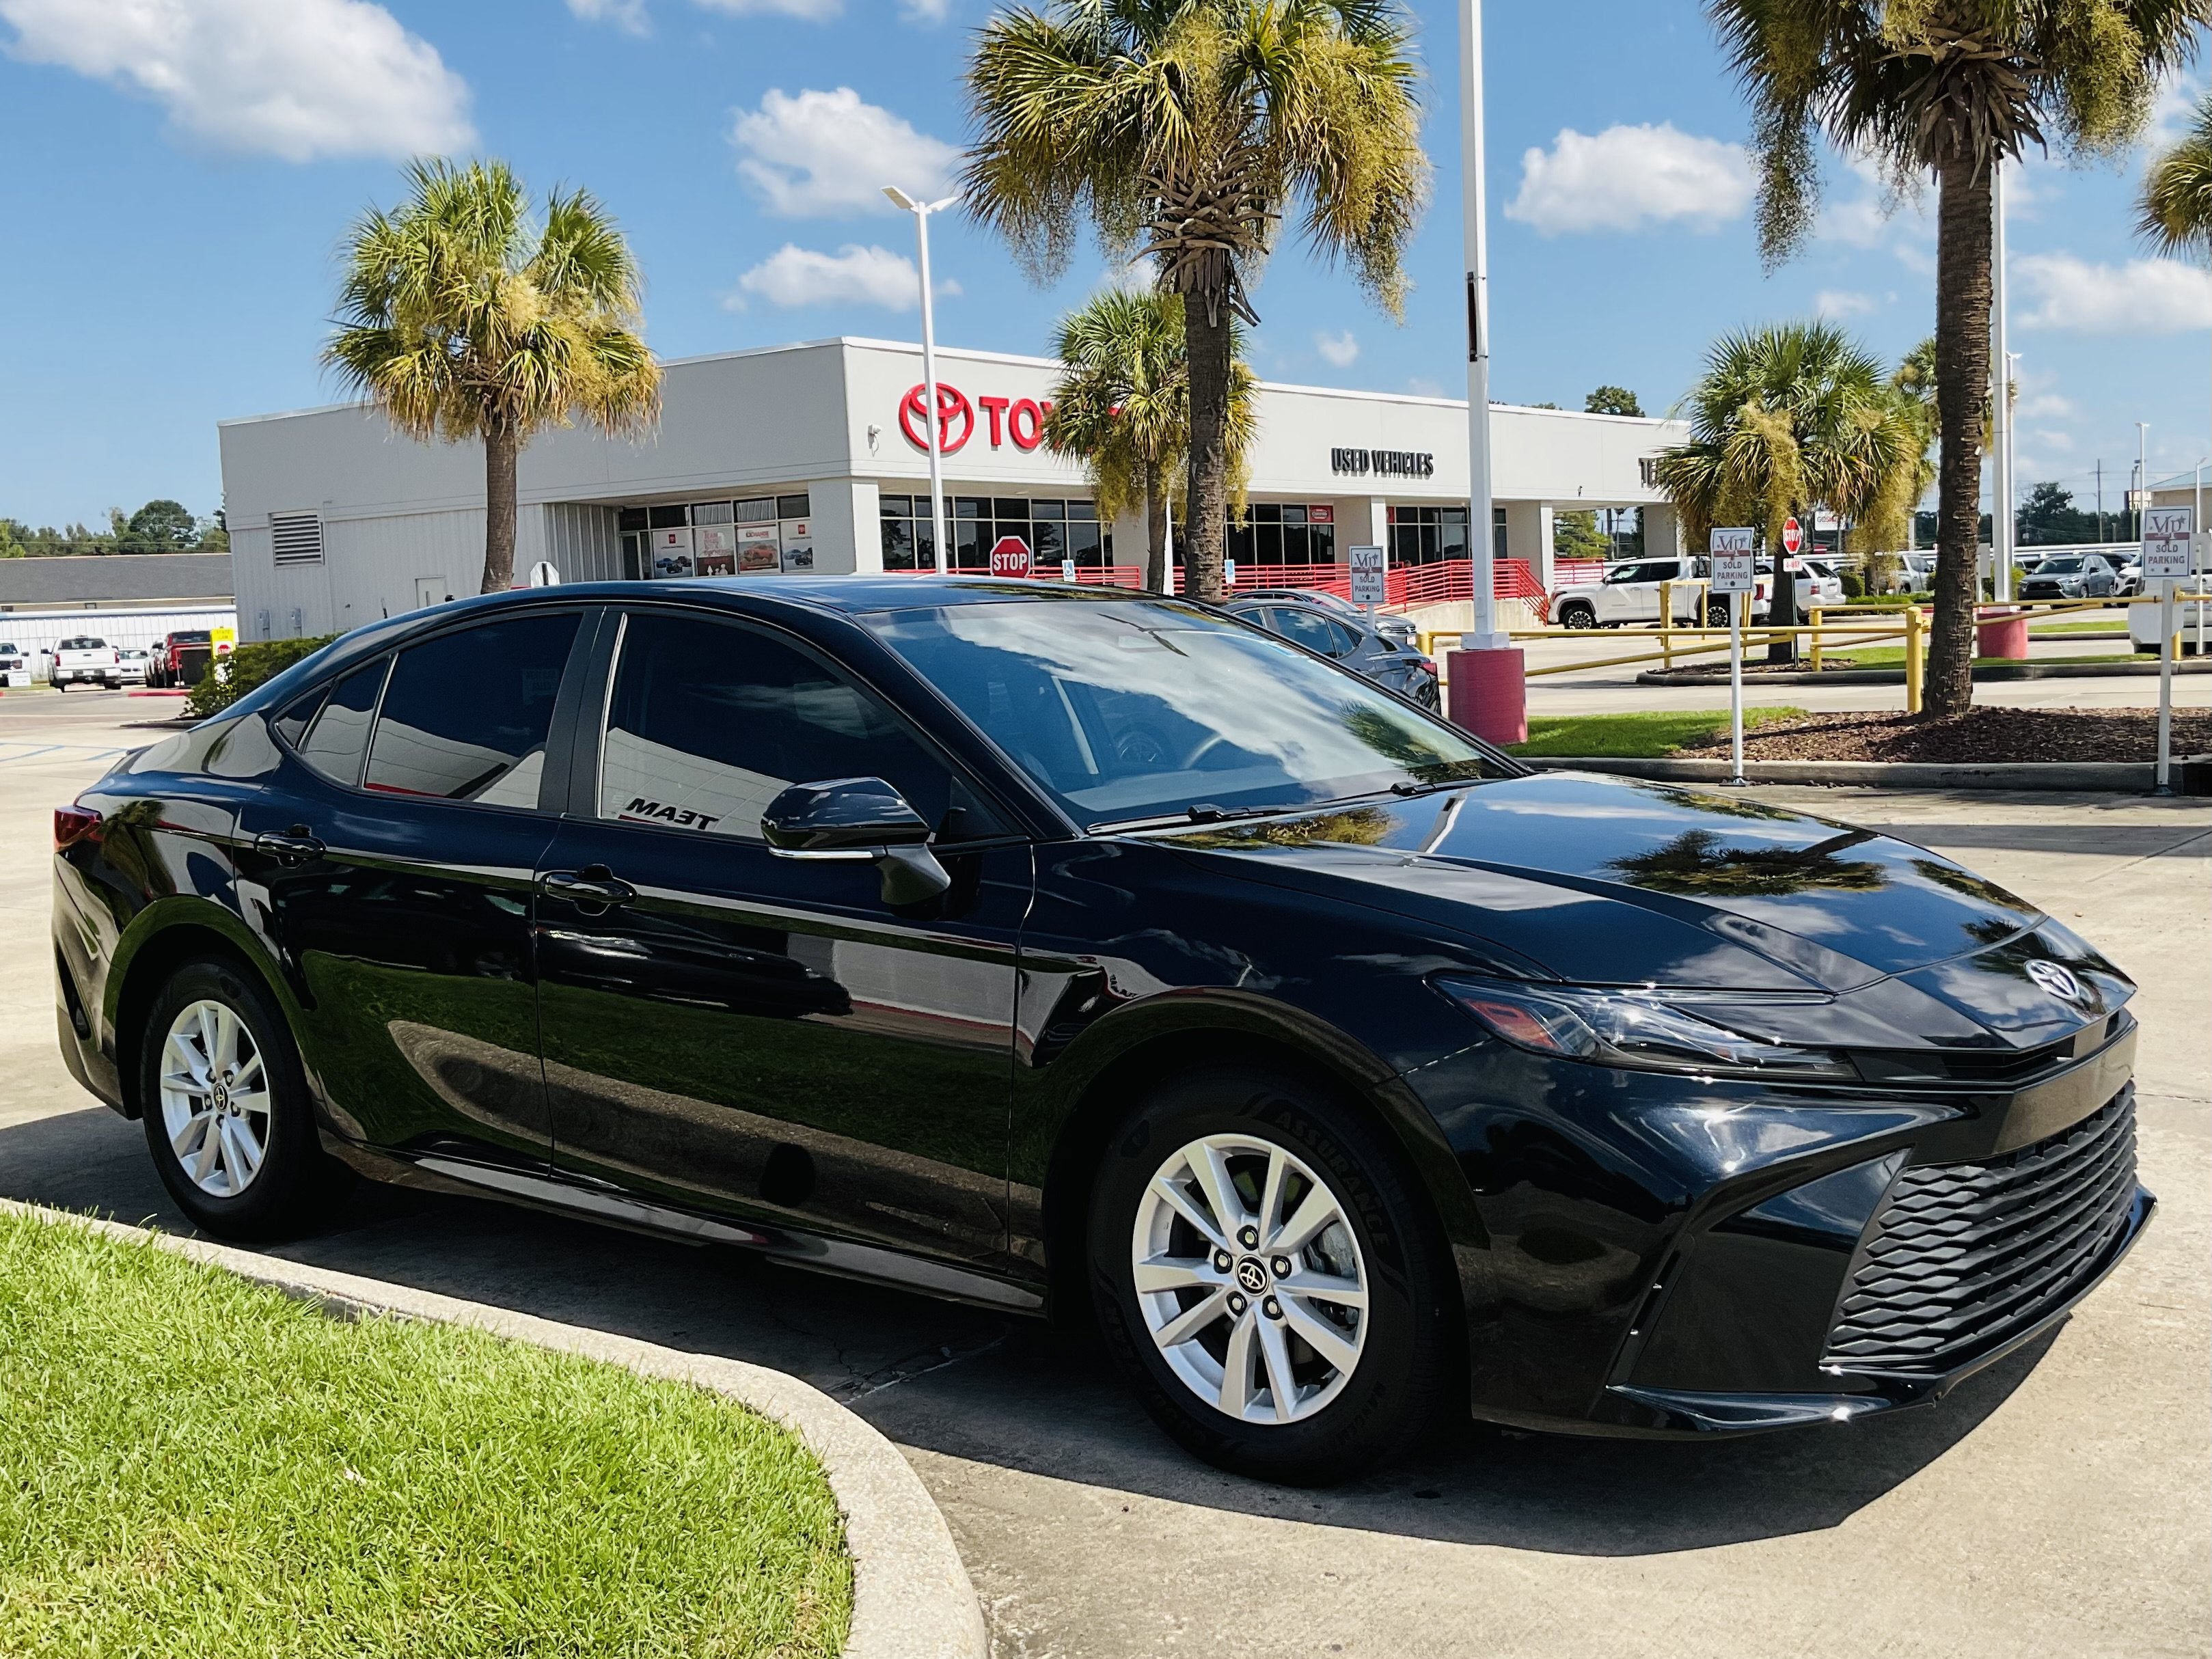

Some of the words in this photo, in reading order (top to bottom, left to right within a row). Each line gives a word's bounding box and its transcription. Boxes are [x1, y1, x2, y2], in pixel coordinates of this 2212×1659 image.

[1331, 448, 1369, 472] USED
[1371, 450, 1434, 476] VEHICLES
[1784, 530, 1800, 542] STOP
[2156, 544, 2179, 553] SOLD
[993, 553, 1028, 571] STOP
[1786, 560, 1800, 568] 4-WAY
[2148, 556, 2185, 564] PARKING
[1723, 561, 1743, 569] SOLD
[1717, 571, 1748, 579] PARKING
